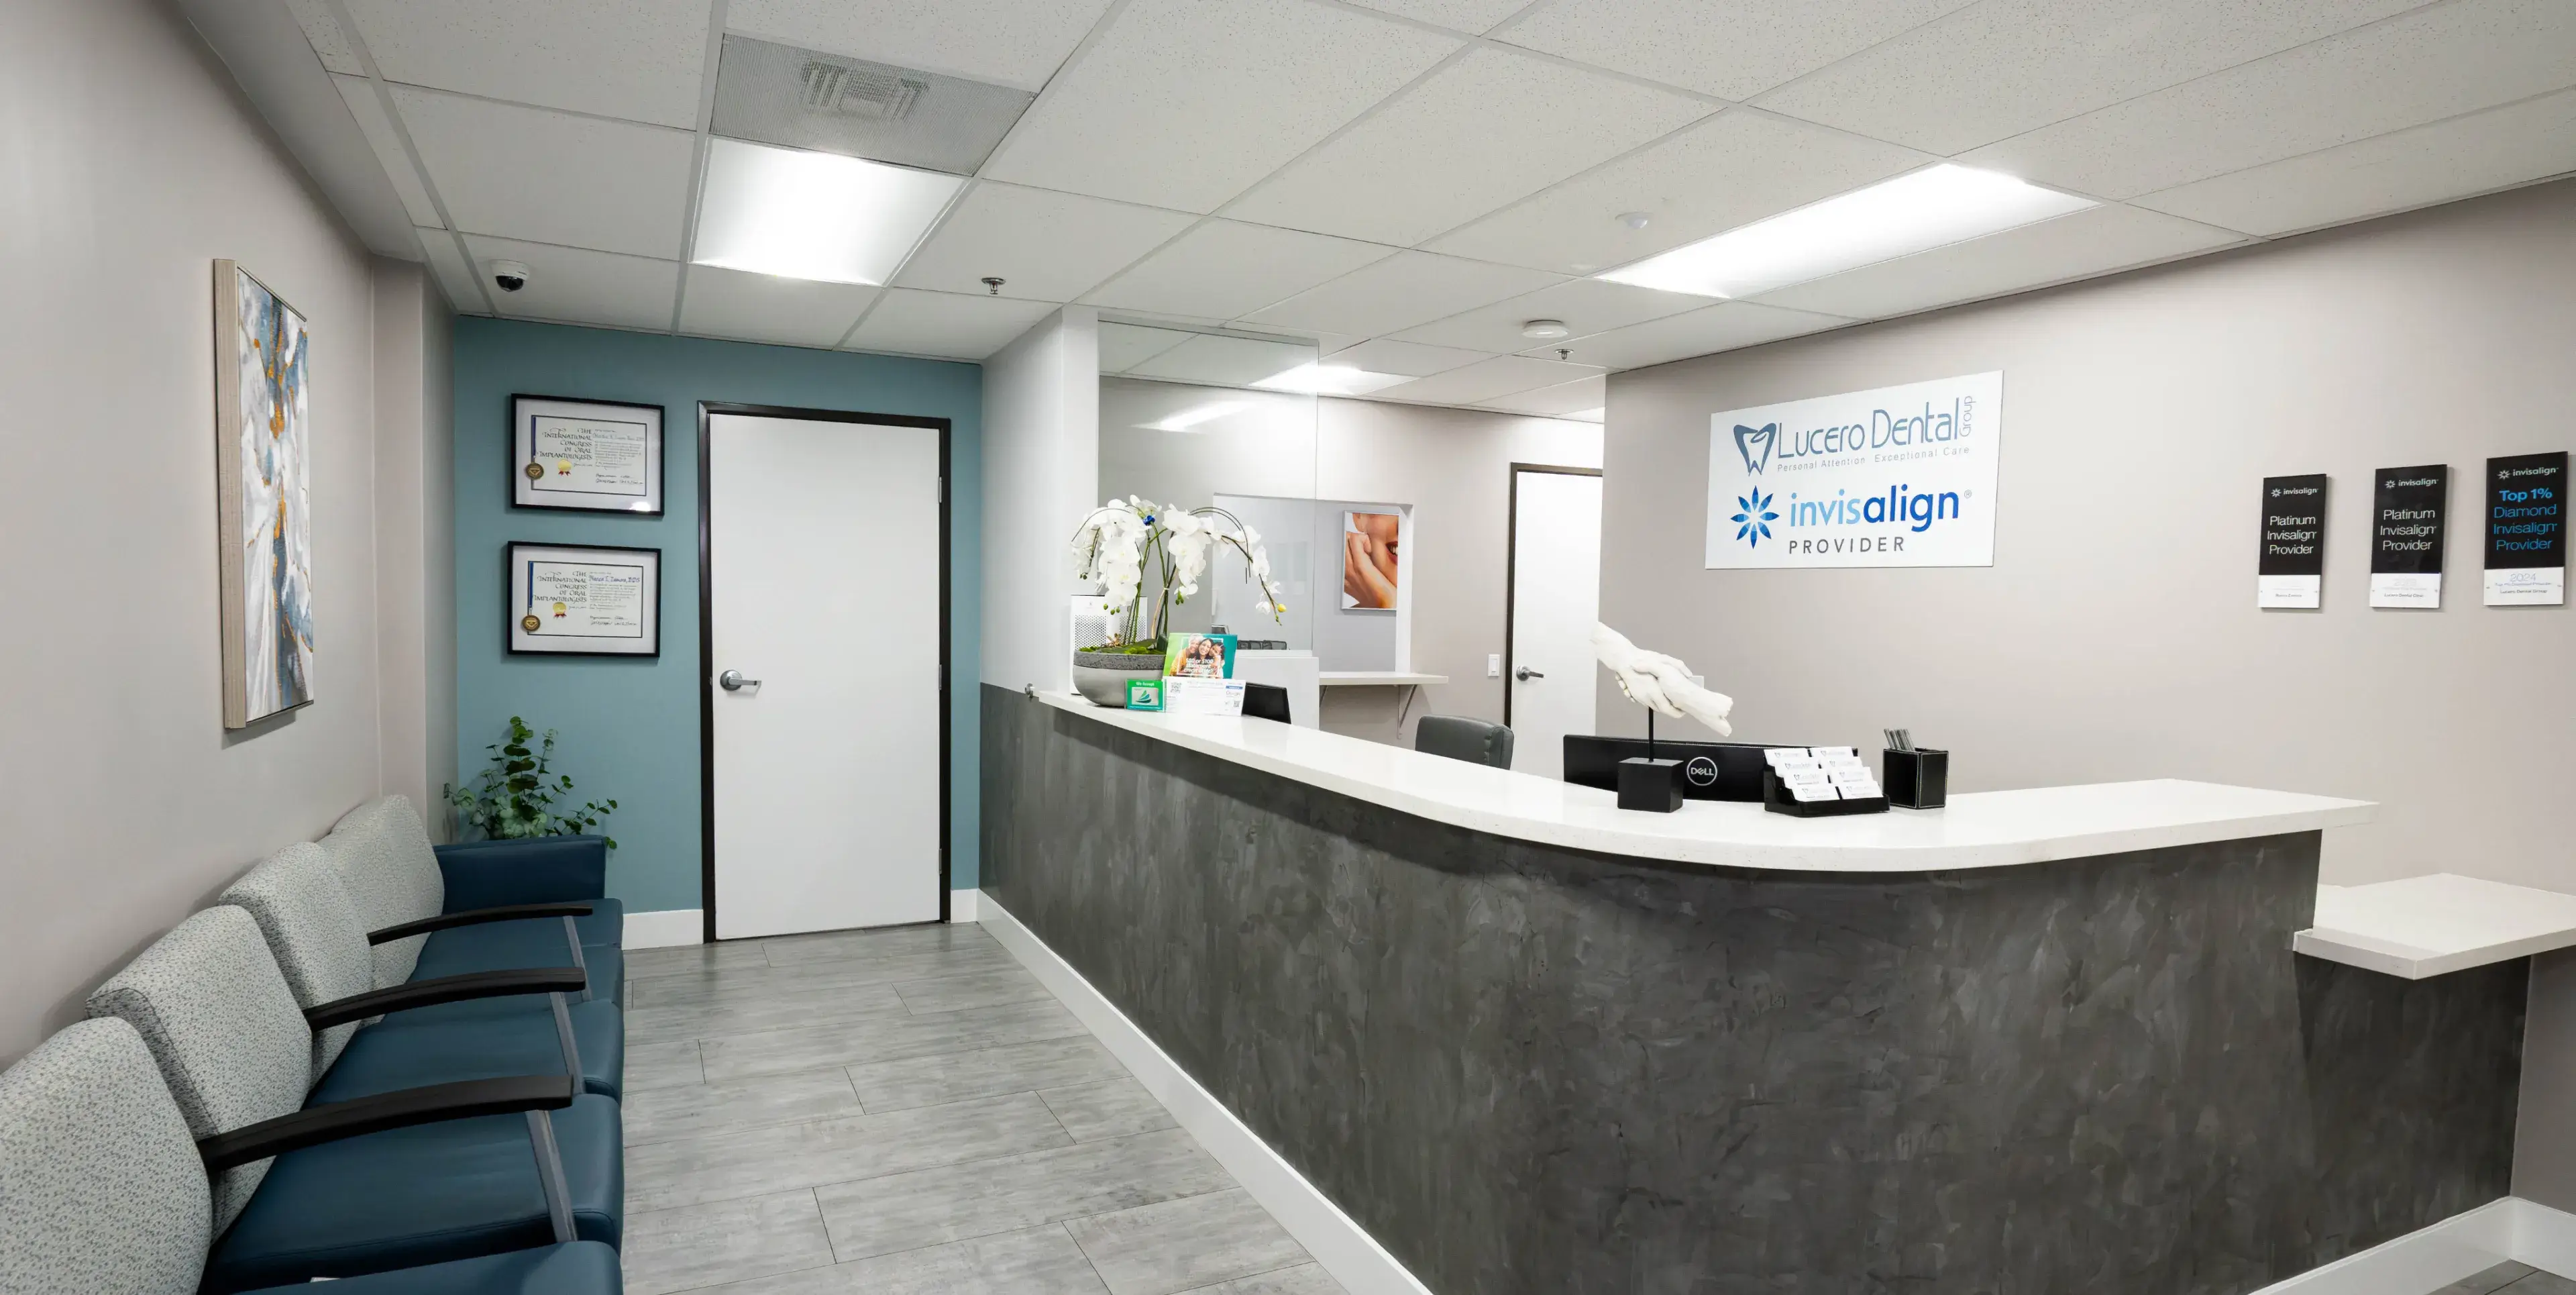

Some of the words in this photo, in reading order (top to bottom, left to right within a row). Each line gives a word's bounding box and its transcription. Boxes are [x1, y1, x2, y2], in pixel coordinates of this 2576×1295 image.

[1959, 395, 1976, 437] Group
[1778, 423, 1866, 459] Lucero
[1871, 397, 1960, 448] Dental
[542, 429, 592, 440] INTERNATIONAL
[537, 451, 592, 460] IMPLANTOLOGISTS
[1777, 460, 1817, 472] Personal
[1874, 450, 1938, 463] Exceptional
[1943, 446, 1970, 456] Care
[2499, 490, 2528, 503] Top
[2530, 488, 2553, 499] 1%
[2383, 509, 2435, 520] Platinum
[2494, 504, 2557, 518] Diamond
[2269, 515, 2316, 525] Platinum
[1789, 537, 1904, 554] PROVIDER
[2269, 544, 2314, 554] Provider
[2383, 539, 2432, 550] Provider
[2496, 538, 2553, 550] Provider
[537, 574, 587, 583] INTERNATIONAL
[2510, 573, 2536, 582] 2024
[534, 594, 587, 604] IMPLANTOLOGISTS
